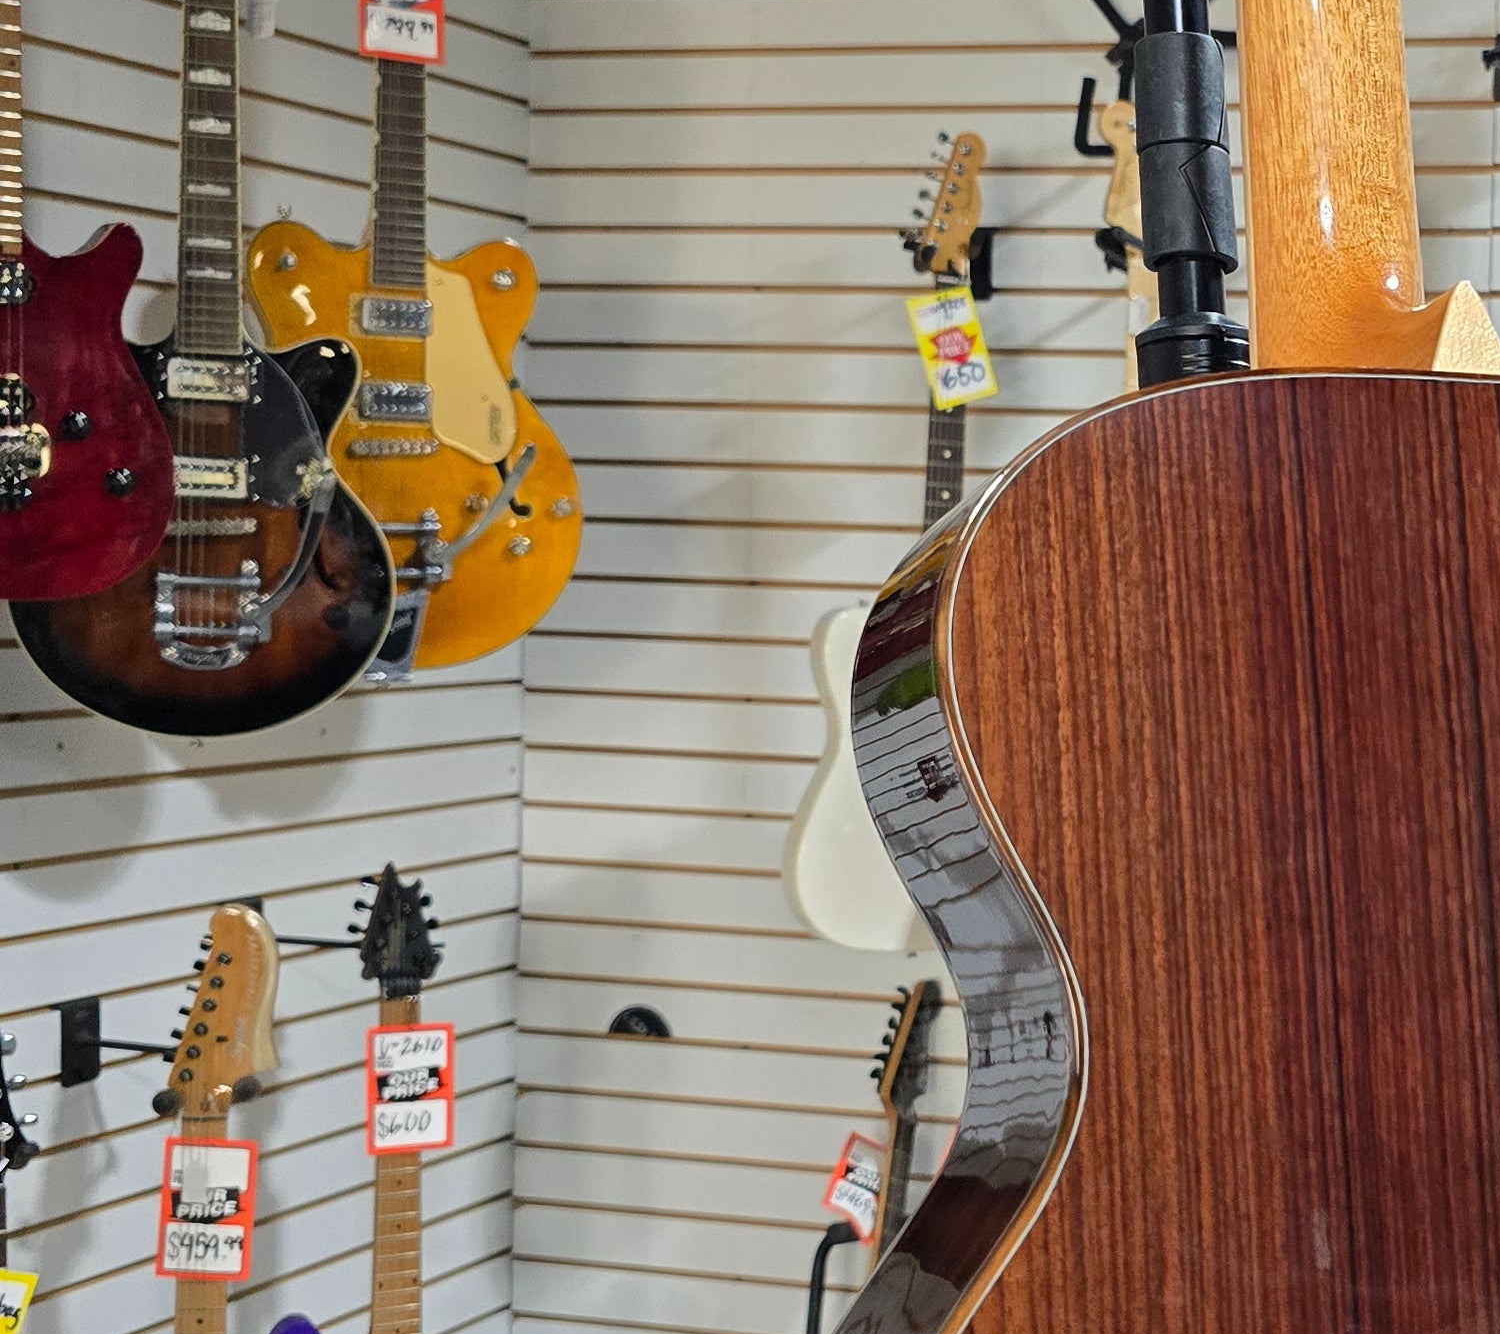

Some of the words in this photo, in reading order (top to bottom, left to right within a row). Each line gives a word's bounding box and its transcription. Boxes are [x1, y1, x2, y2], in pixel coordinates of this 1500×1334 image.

[387, 1069, 430, 1087] OUR
[381, 1077, 440, 1101] PRICE
[378, 1110, 431, 1140] $600
[176, 1200, 238, 1219] PRICE
